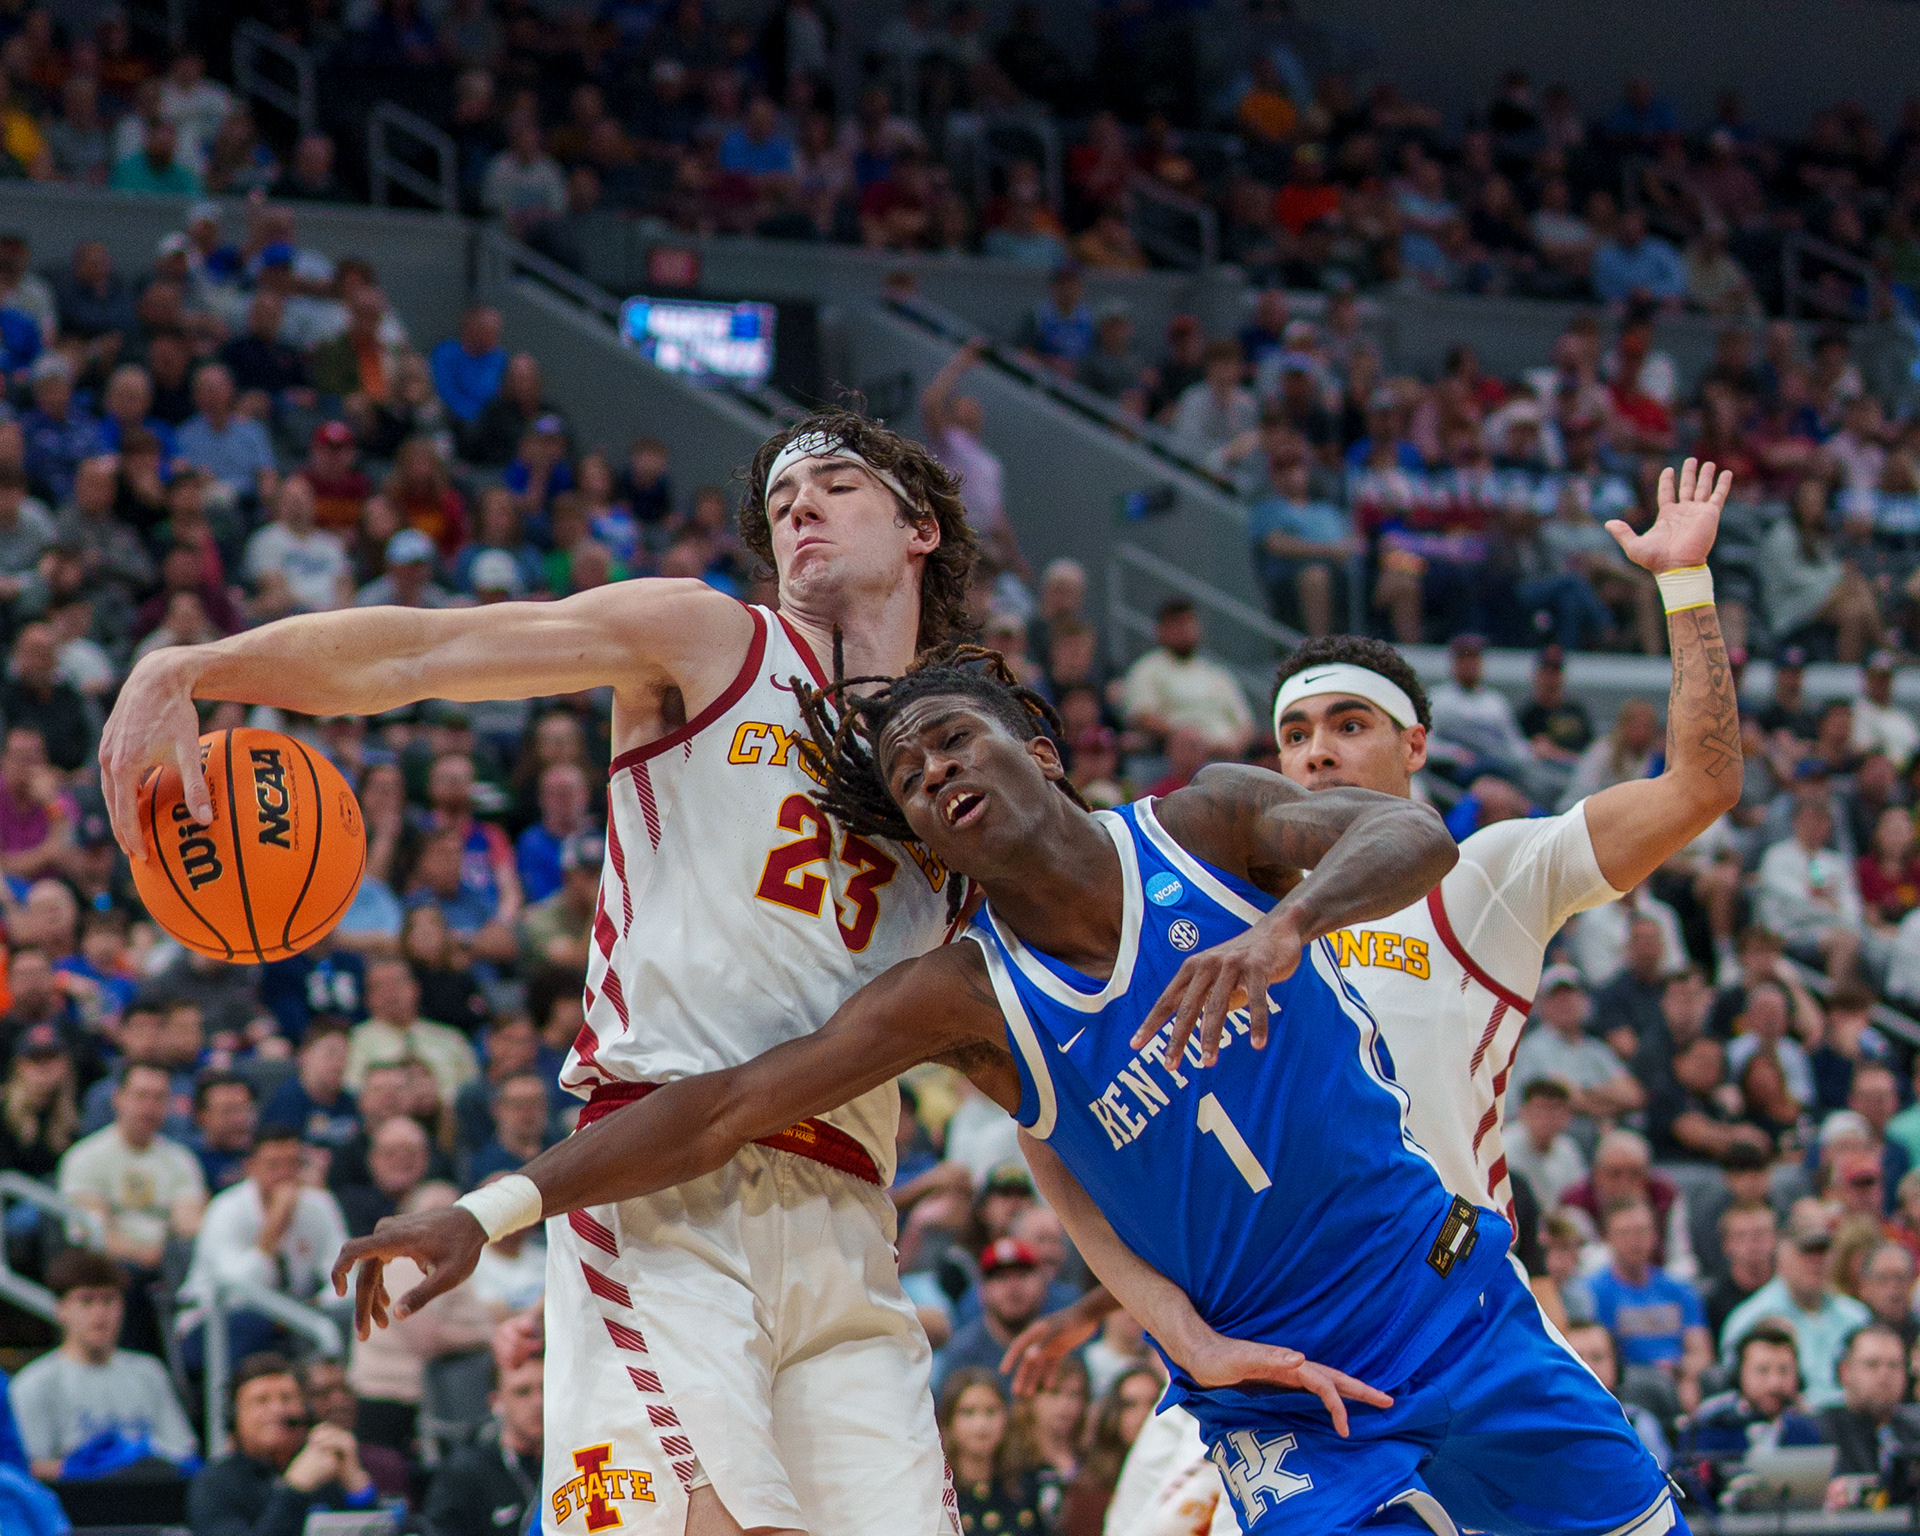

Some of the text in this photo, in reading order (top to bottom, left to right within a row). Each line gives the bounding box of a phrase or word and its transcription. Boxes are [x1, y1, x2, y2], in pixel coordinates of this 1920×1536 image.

[248, 747, 292, 851] NCAA
[754, 792, 900, 954] 23
[1153, 880, 1183, 903] NCAA
[1170, 921, 1197, 950] SEC
[1197, 1092, 1272, 1194] 1
[551, 1469, 656, 1525] STATE
